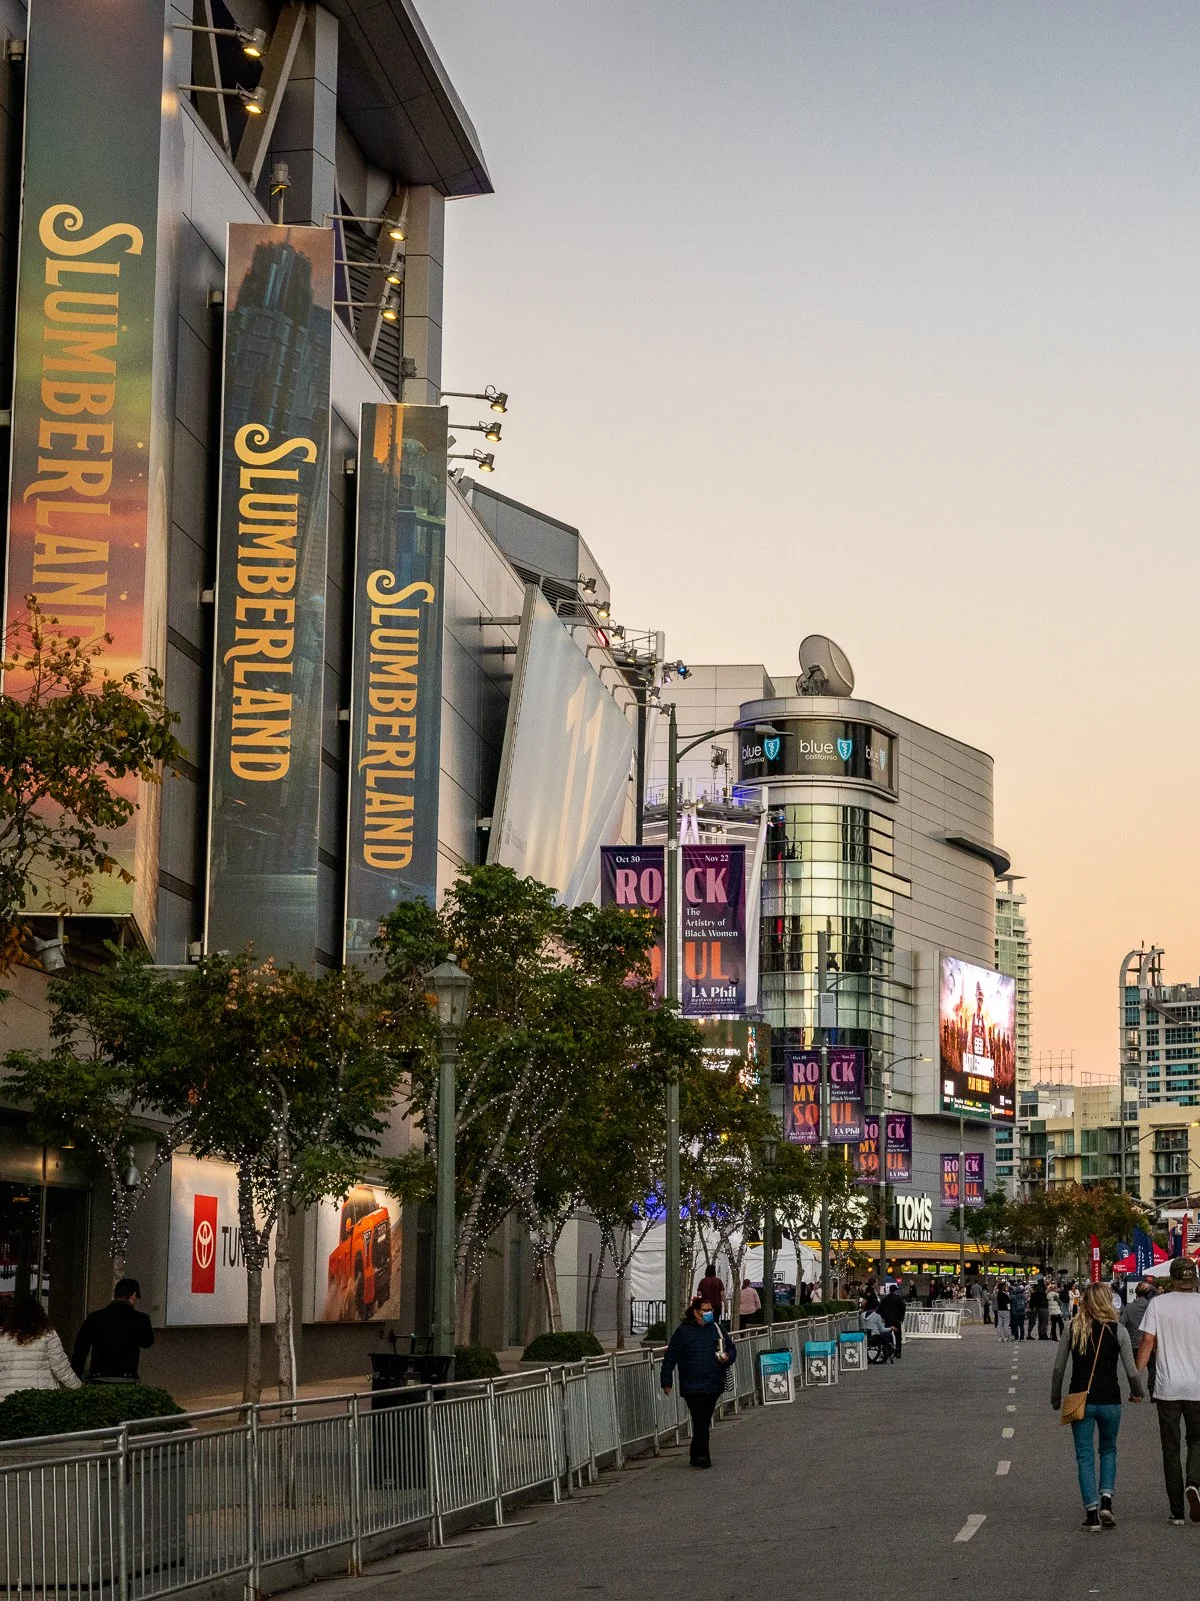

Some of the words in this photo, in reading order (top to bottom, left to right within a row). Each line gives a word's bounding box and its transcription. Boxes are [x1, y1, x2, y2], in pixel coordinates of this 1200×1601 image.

[24, 204, 144, 650] SLUMBERLAND
[224, 423, 316, 781] SLUMBERLAND
[359, 569, 434, 869] SLUMBERLAND
[742, 745, 762, 759] blue
[800, 740, 834, 754] blue
[744, 757, 765, 766] california
[686, 918, 715, 927] Artistry
[718, 918, 726, 926] of
[692, 987, 707, 997] LA
[710, 987, 736, 998] Phil
[794, 1085, 816, 1101] MY
[860, 1140, 876, 1152] MY
[944, 1173, 957, 1182] MY
[896, 1193, 932, 1229] TOM'S
[758, 1229, 821, 1240] WCH
[831, 1229, 863, 1239] BAR
[900, 1230, 918, 1240] WATCH
[920, 1230, 932, 1241] BAR
[222, 1226, 270, 1268] TUN
